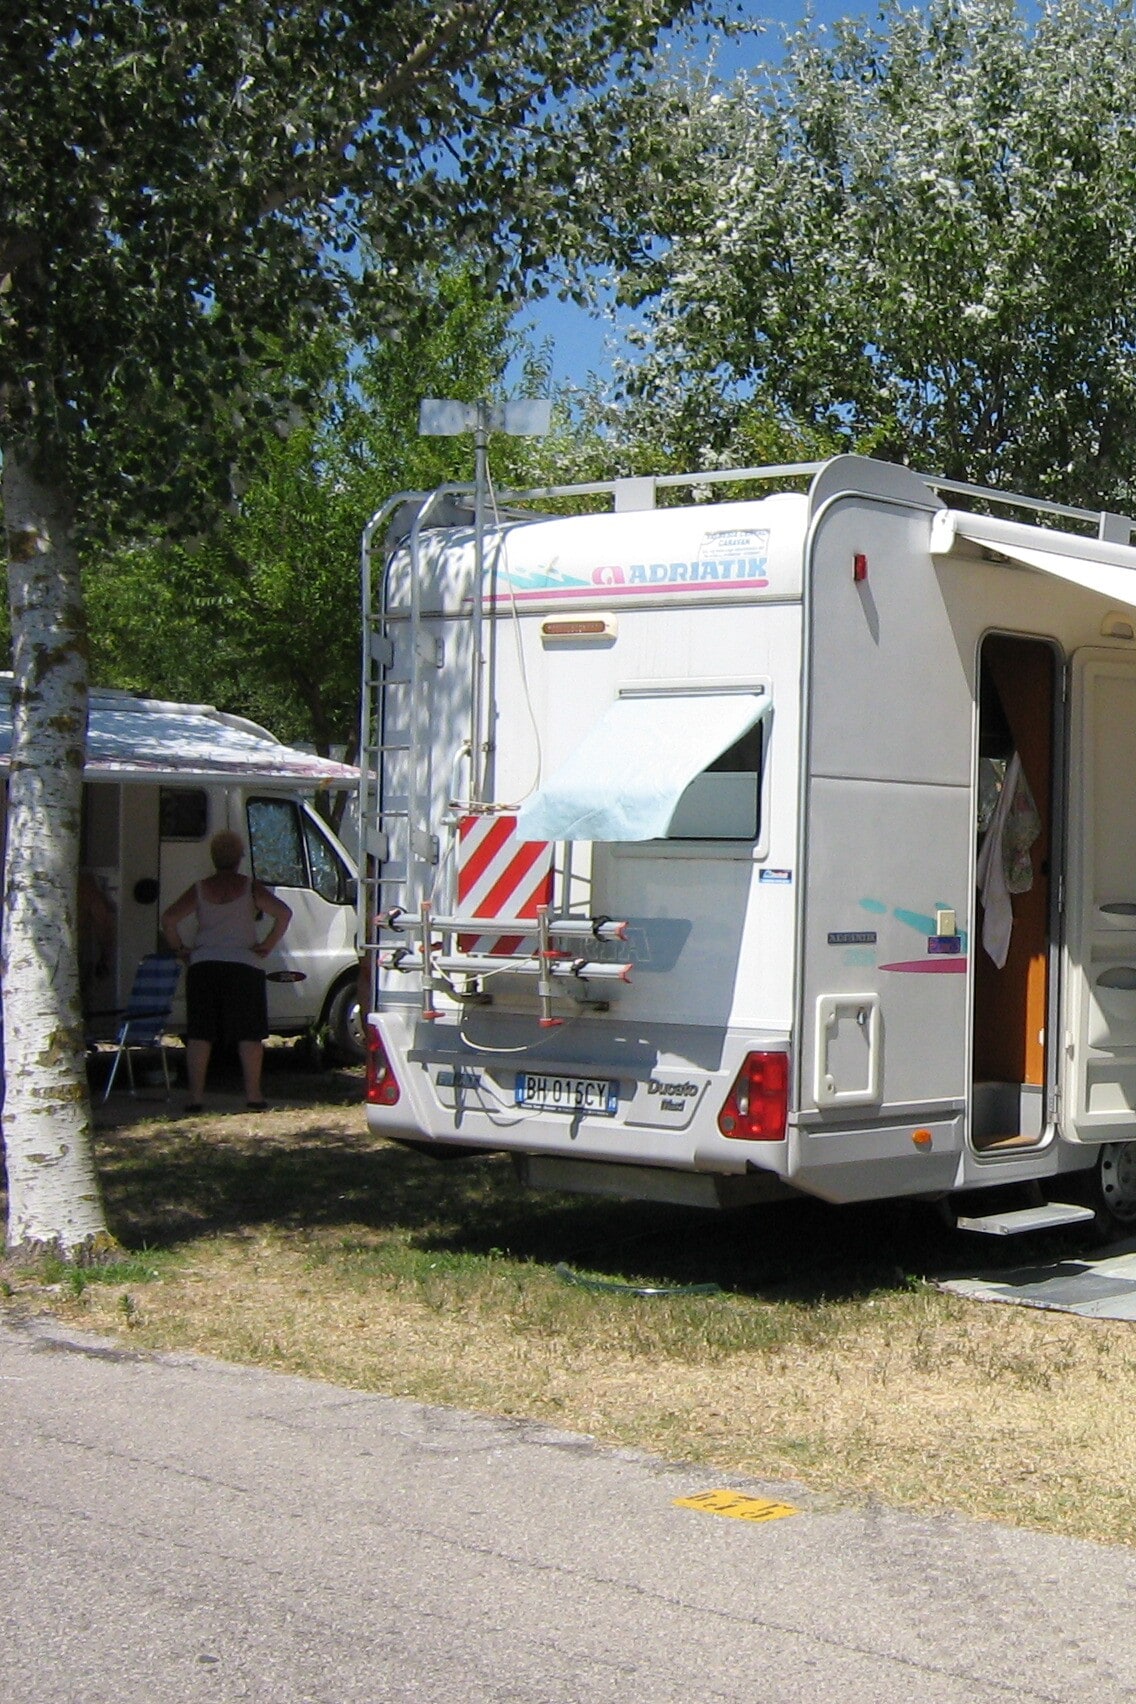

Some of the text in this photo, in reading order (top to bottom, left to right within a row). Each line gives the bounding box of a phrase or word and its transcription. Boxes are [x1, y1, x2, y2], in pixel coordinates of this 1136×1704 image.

[629, 557, 767, 584] ADRIATIK
[527, 1077, 546, 1101] BH
[647, 1078, 699, 1097] Ducato
